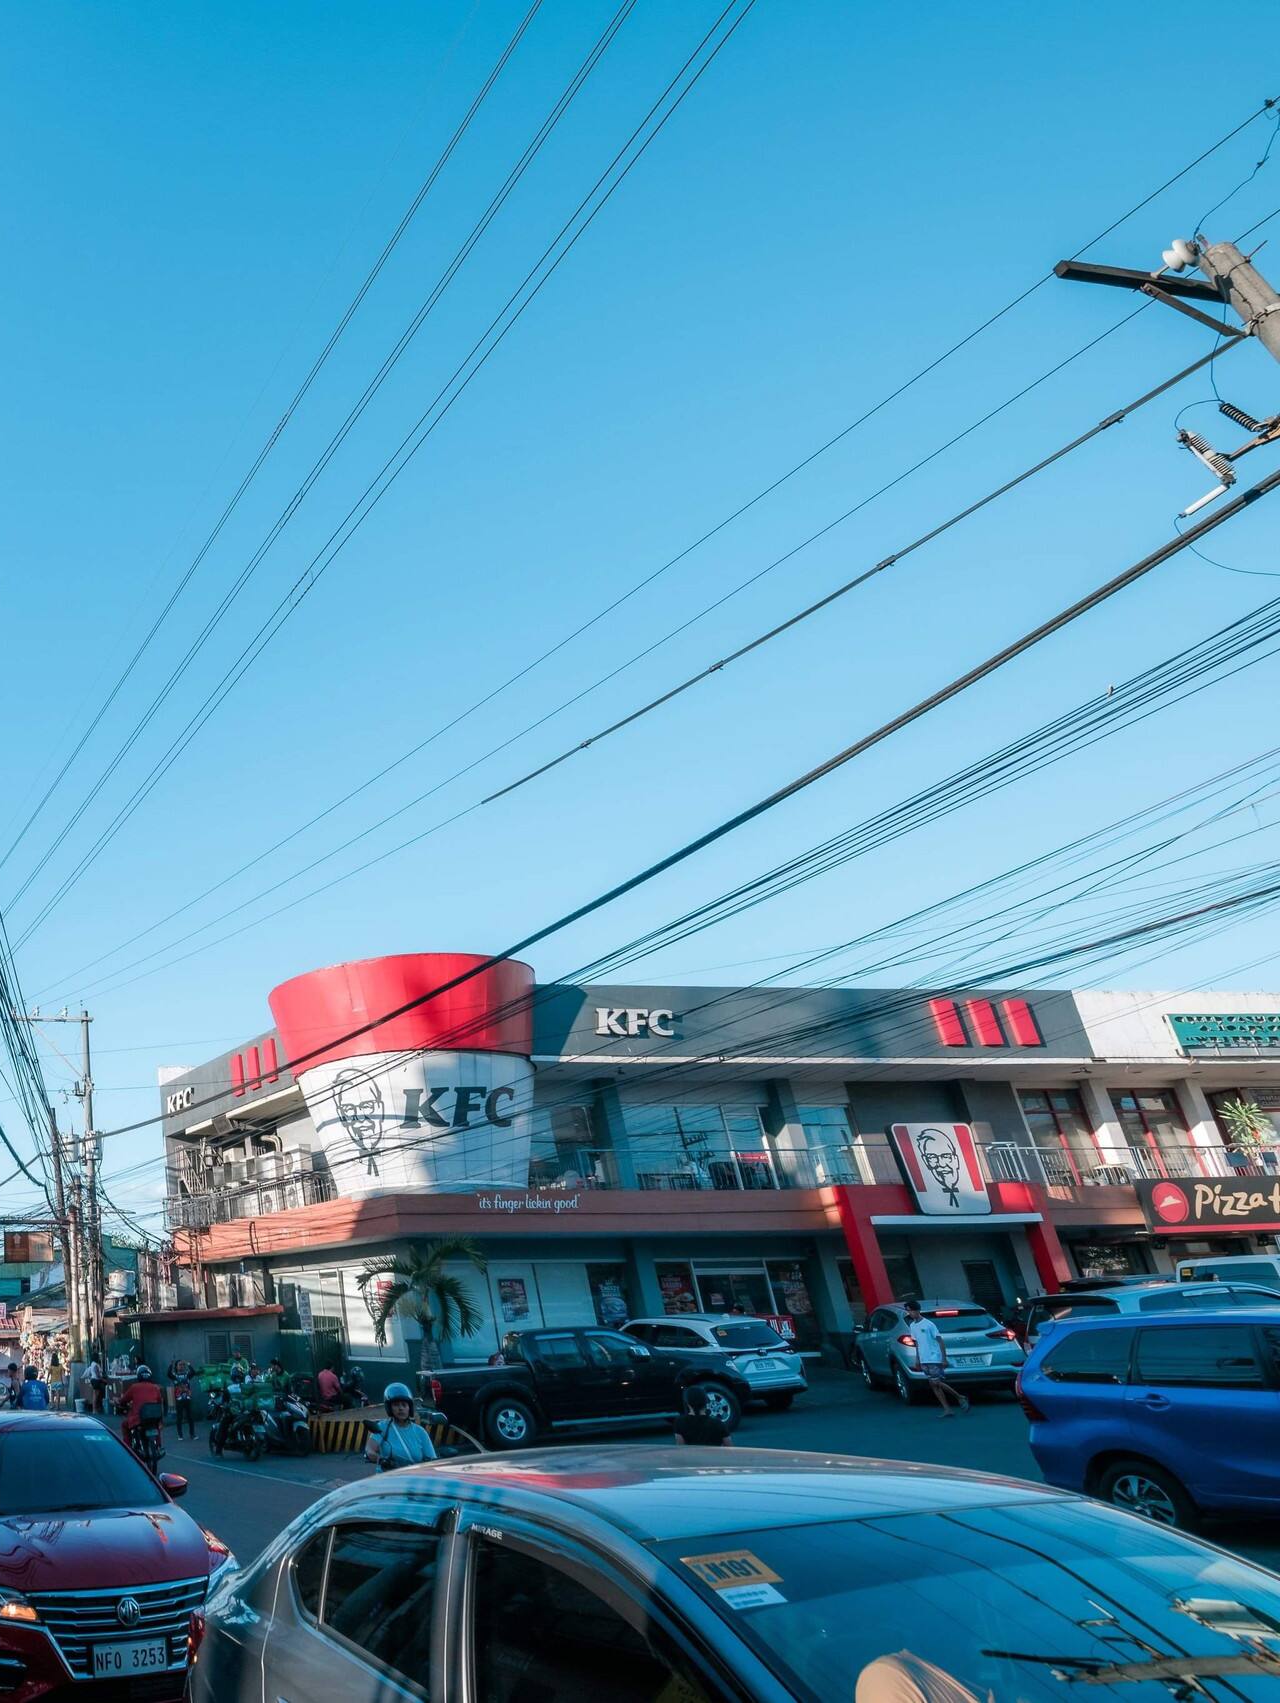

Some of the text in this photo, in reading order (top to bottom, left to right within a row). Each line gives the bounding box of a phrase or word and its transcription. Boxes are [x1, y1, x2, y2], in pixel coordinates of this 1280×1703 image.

[596, 1007, 675, 1037] KFC
[166, 1086, 193, 1114] KFC
[399, 1086, 515, 1129] KFC
[1194, 1182, 1269, 1220] Pizza
[96, 1646, 166, 1671] NFO 3253
